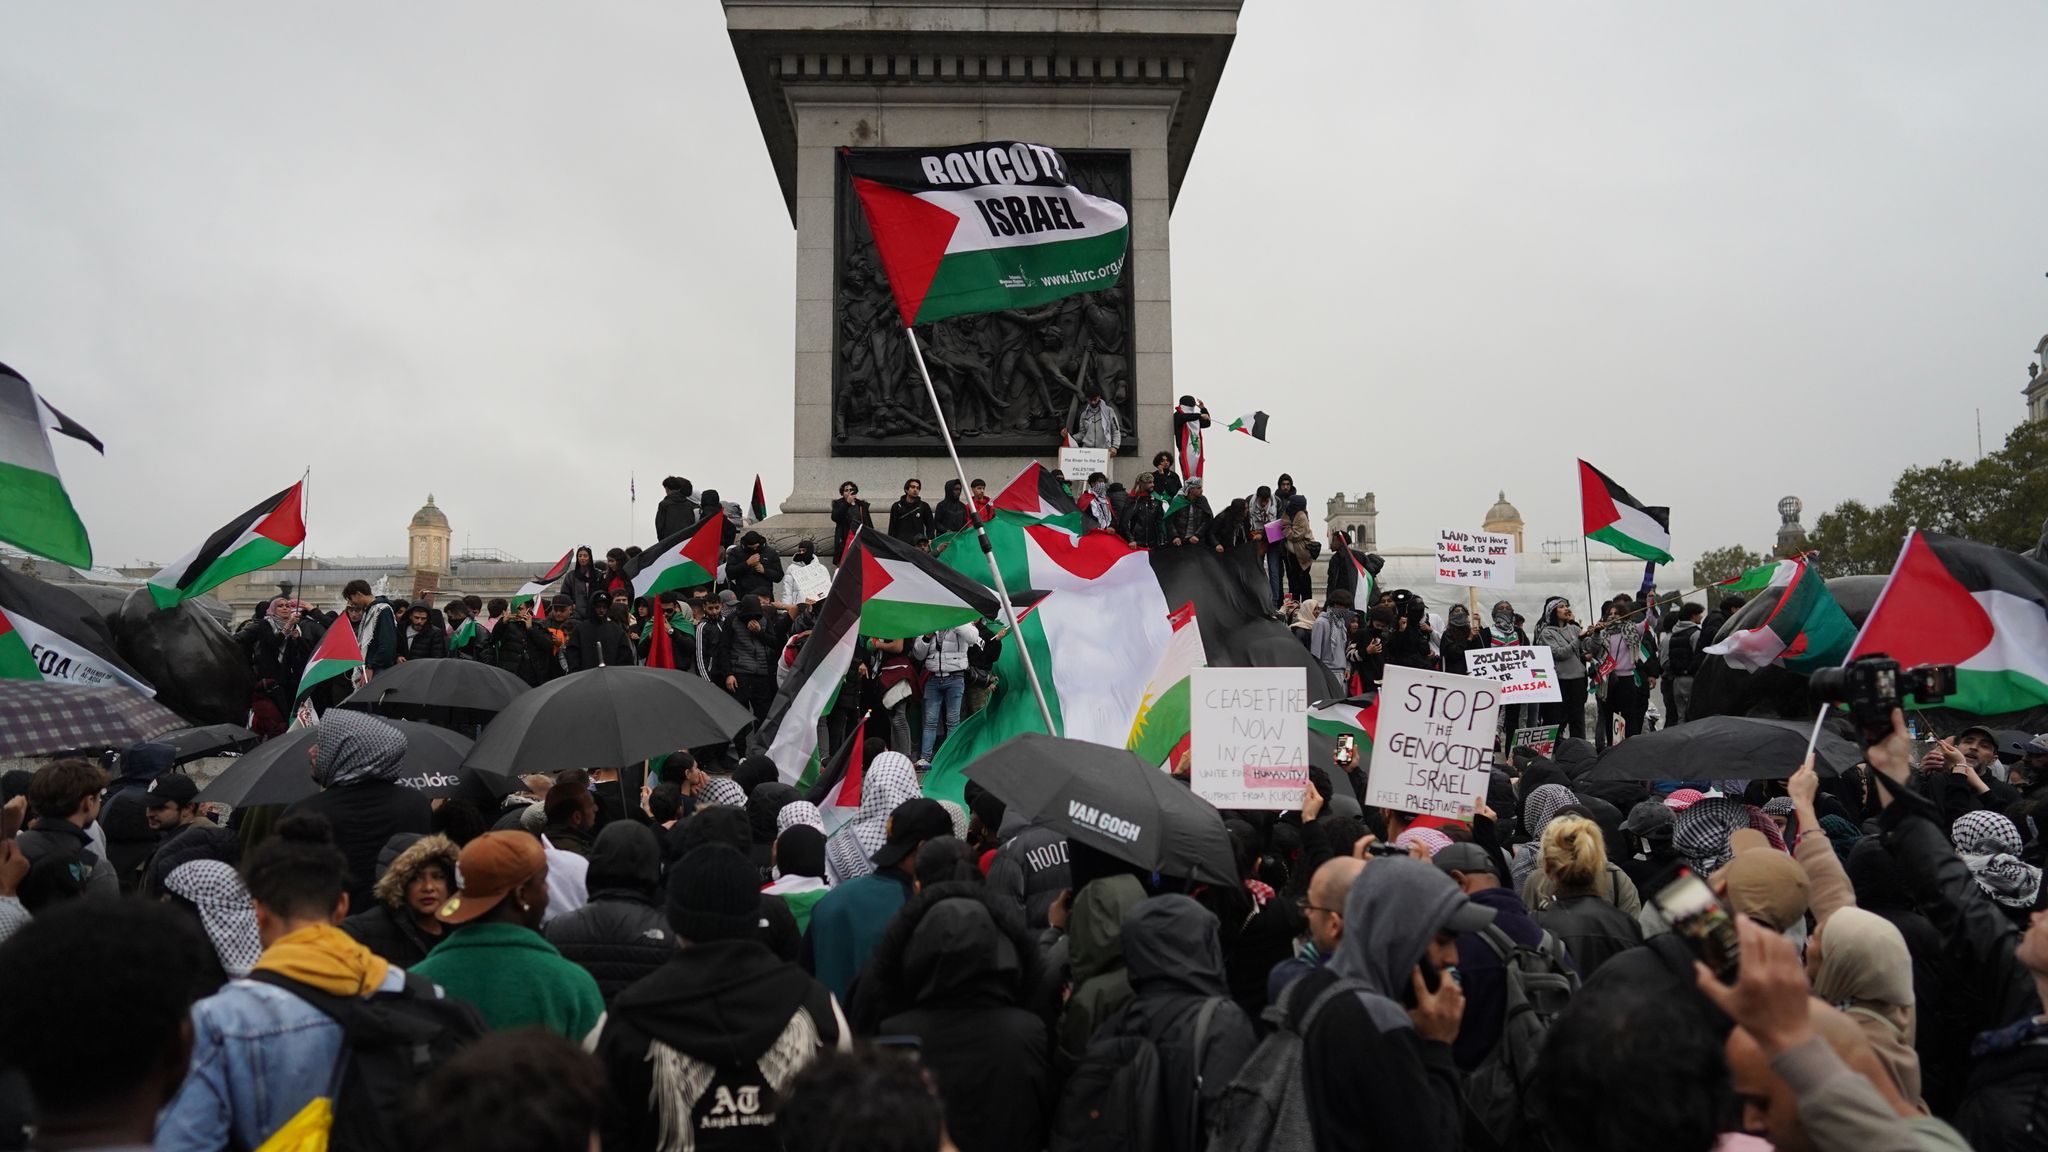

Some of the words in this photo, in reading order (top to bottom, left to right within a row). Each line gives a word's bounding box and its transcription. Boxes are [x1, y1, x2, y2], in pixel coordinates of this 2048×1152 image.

[921, 142, 1064, 185] BOYCOTT
[975, 195, 1085, 237] ISRAEL
[1441, 530, 1469, 541] LAND
[1472, 535, 1487, 543] YOU
[1489, 536, 1508, 545] HAVE
[1447, 543, 1461, 552] KILL
[1477, 545, 1485, 553] IS
[1488, 546, 1508, 554] NOT
[1462, 555, 1482, 564] LAND
[1440, 568, 1456, 577] DIE
[1472, 569, 1481, 577] IS
[31, 643, 72, 679] FOA
[1473, 666, 1488, 677] IS
[1206, 688, 1306, 713] CEASEFIRE
[1404, 683, 1495, 731] STOP
[1232, 716, 1285, 740] NOW
[1424, 722, 1453, 736] THE
[1516, 729, 1549, 746] FREE
[1217, 743, 1236, 762] IN
[1241, 745, 1303, 769] GAZA
[1389, 732, 1493, 773] GENOCIDE
[1200, 768, 1228, 778] UNITE
[1405, 762, 1471, 796] ISRAEL
[1241, 791, 1265, 801] FROM
[1376, 790, 1400, 804] FREE
[1405, 794, 1461, 814] PALESTINE
[1068, 799, 1100, 825] VAN
[1099, 813, 1142, 842] GOGH
[710, 1085, 760, 1115] AT
